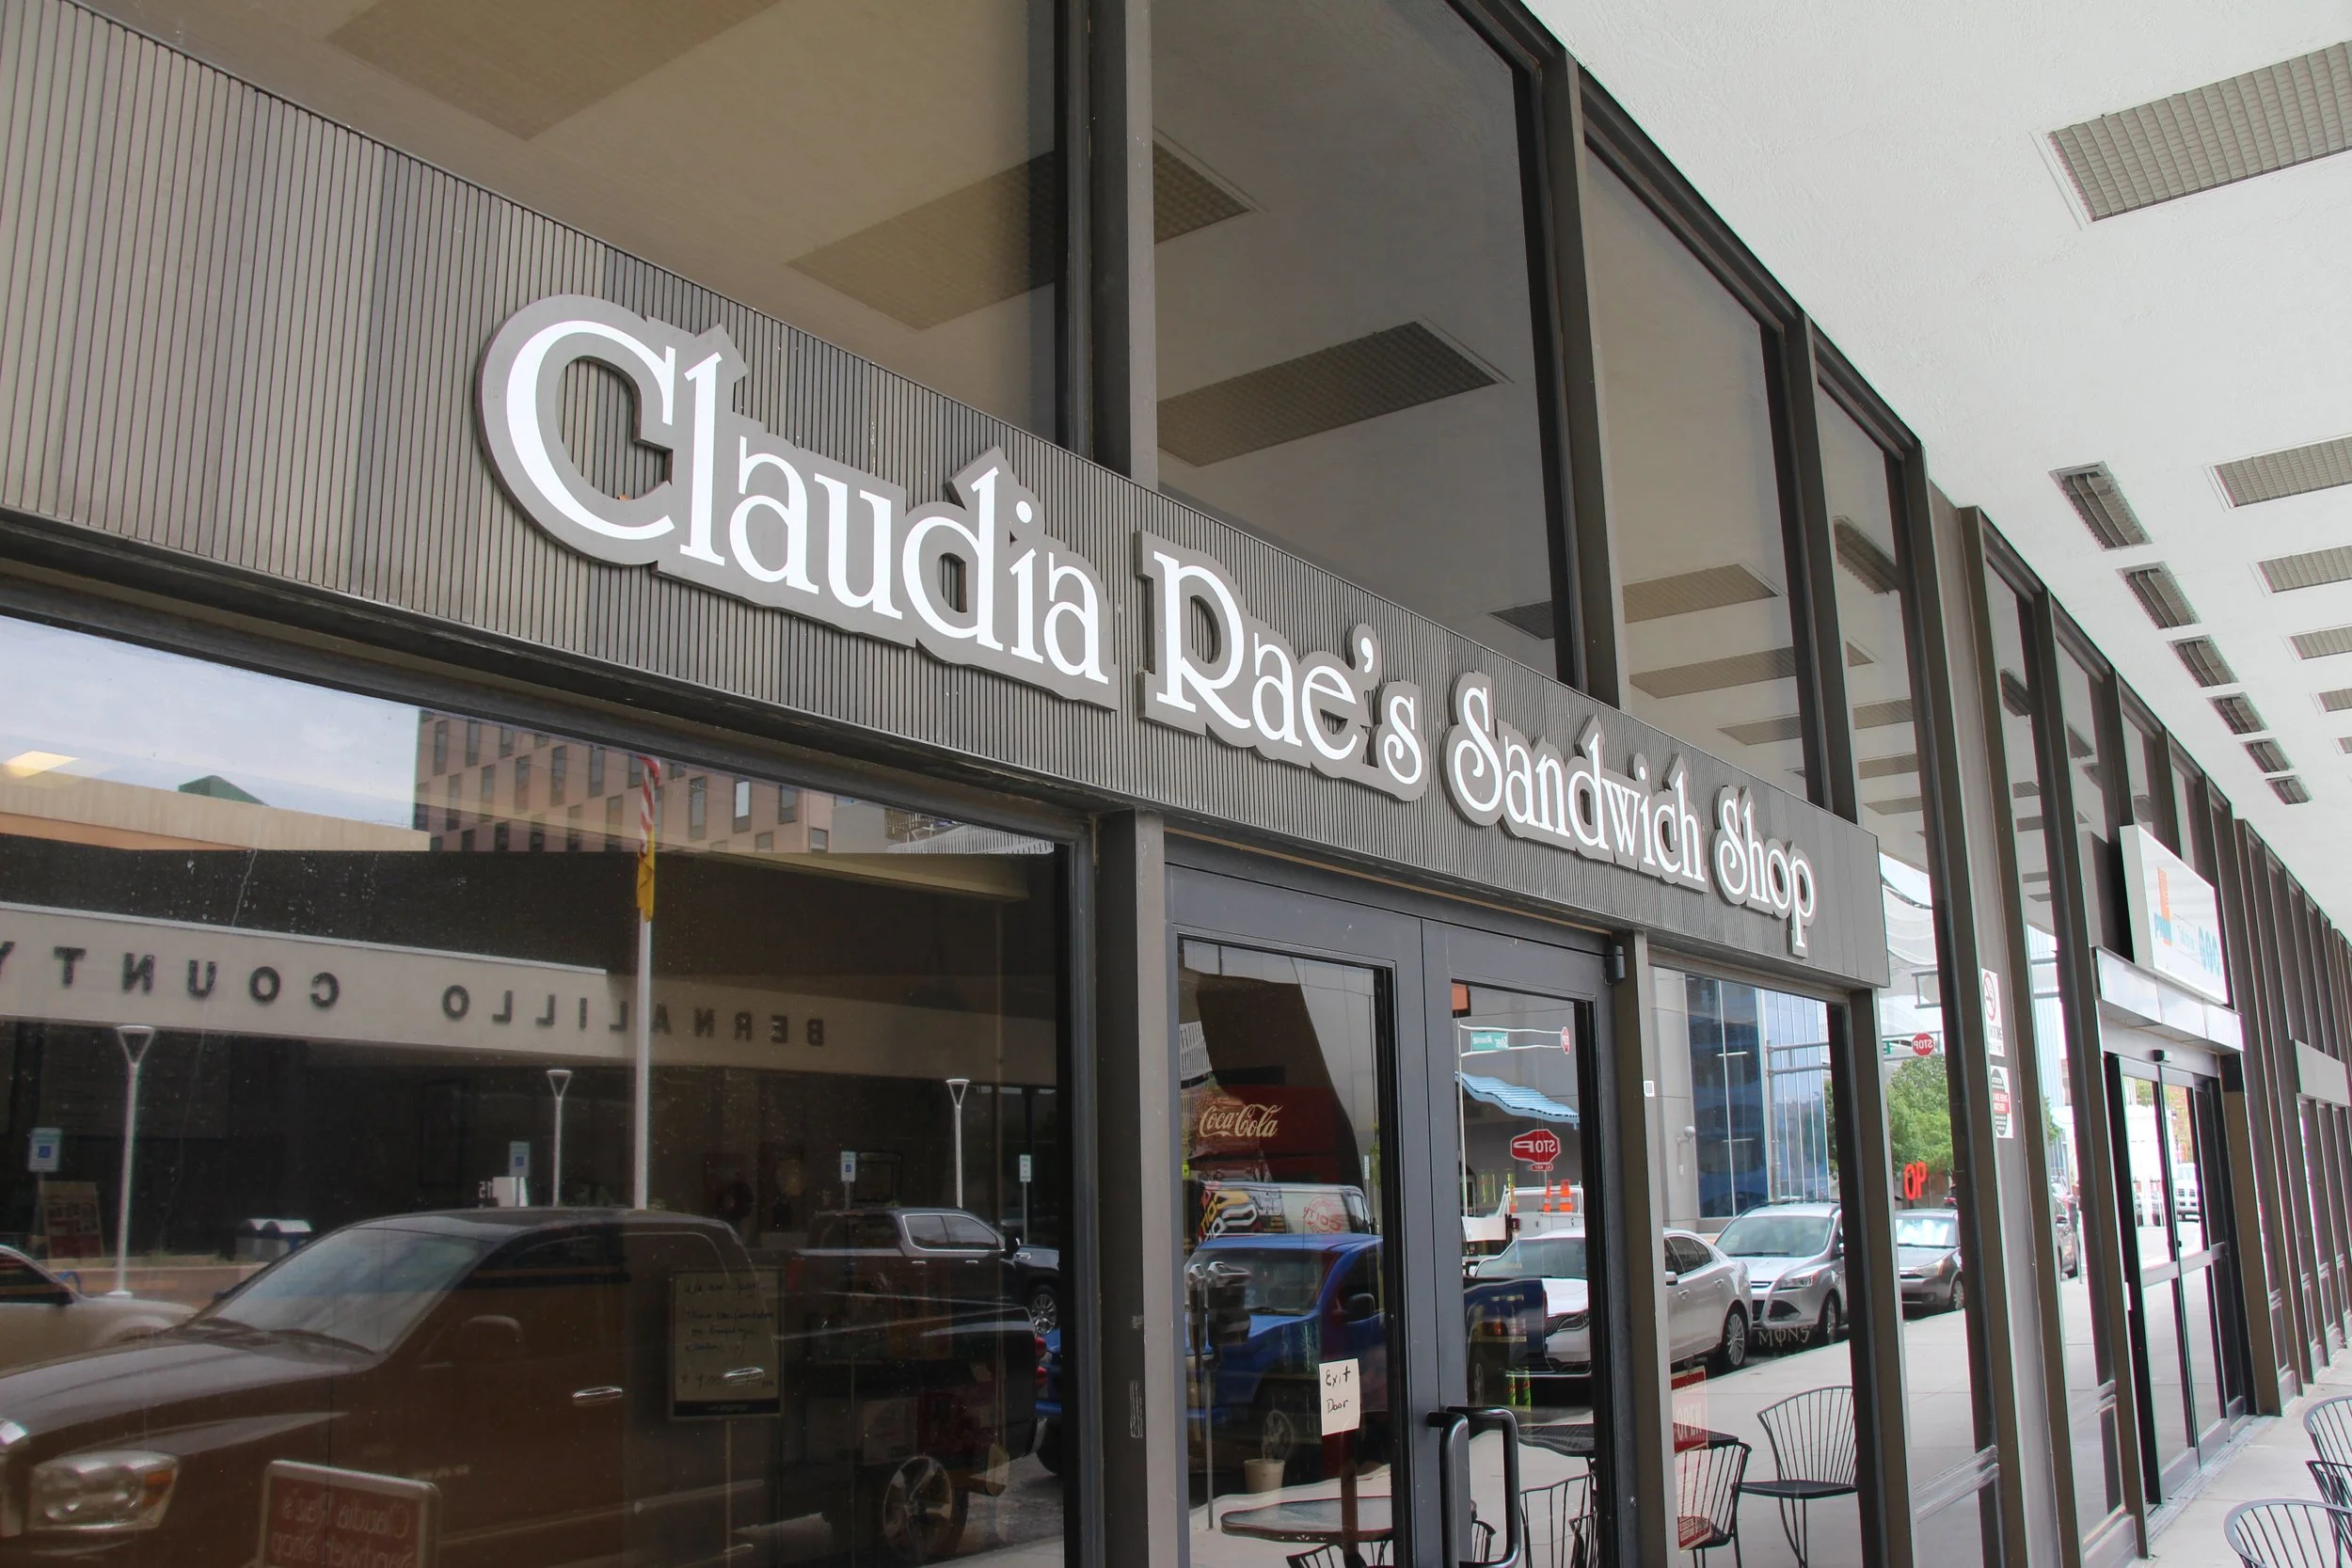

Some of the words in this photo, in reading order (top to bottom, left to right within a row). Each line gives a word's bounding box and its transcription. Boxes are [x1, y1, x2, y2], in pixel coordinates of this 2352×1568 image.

[505, 319, 1109, 686] Claudia
[1152, 549, 1423, 784] Rae's
[1454, 685, 1706, 881] Sandwich
[1720, 798, 1815, 947] Shop
[1200, 1103, 1283, 1138] Coca-Cola
[1325, 1365, 1352, 1387] Exit
[1326, 1398, 1349, 1414] Door
